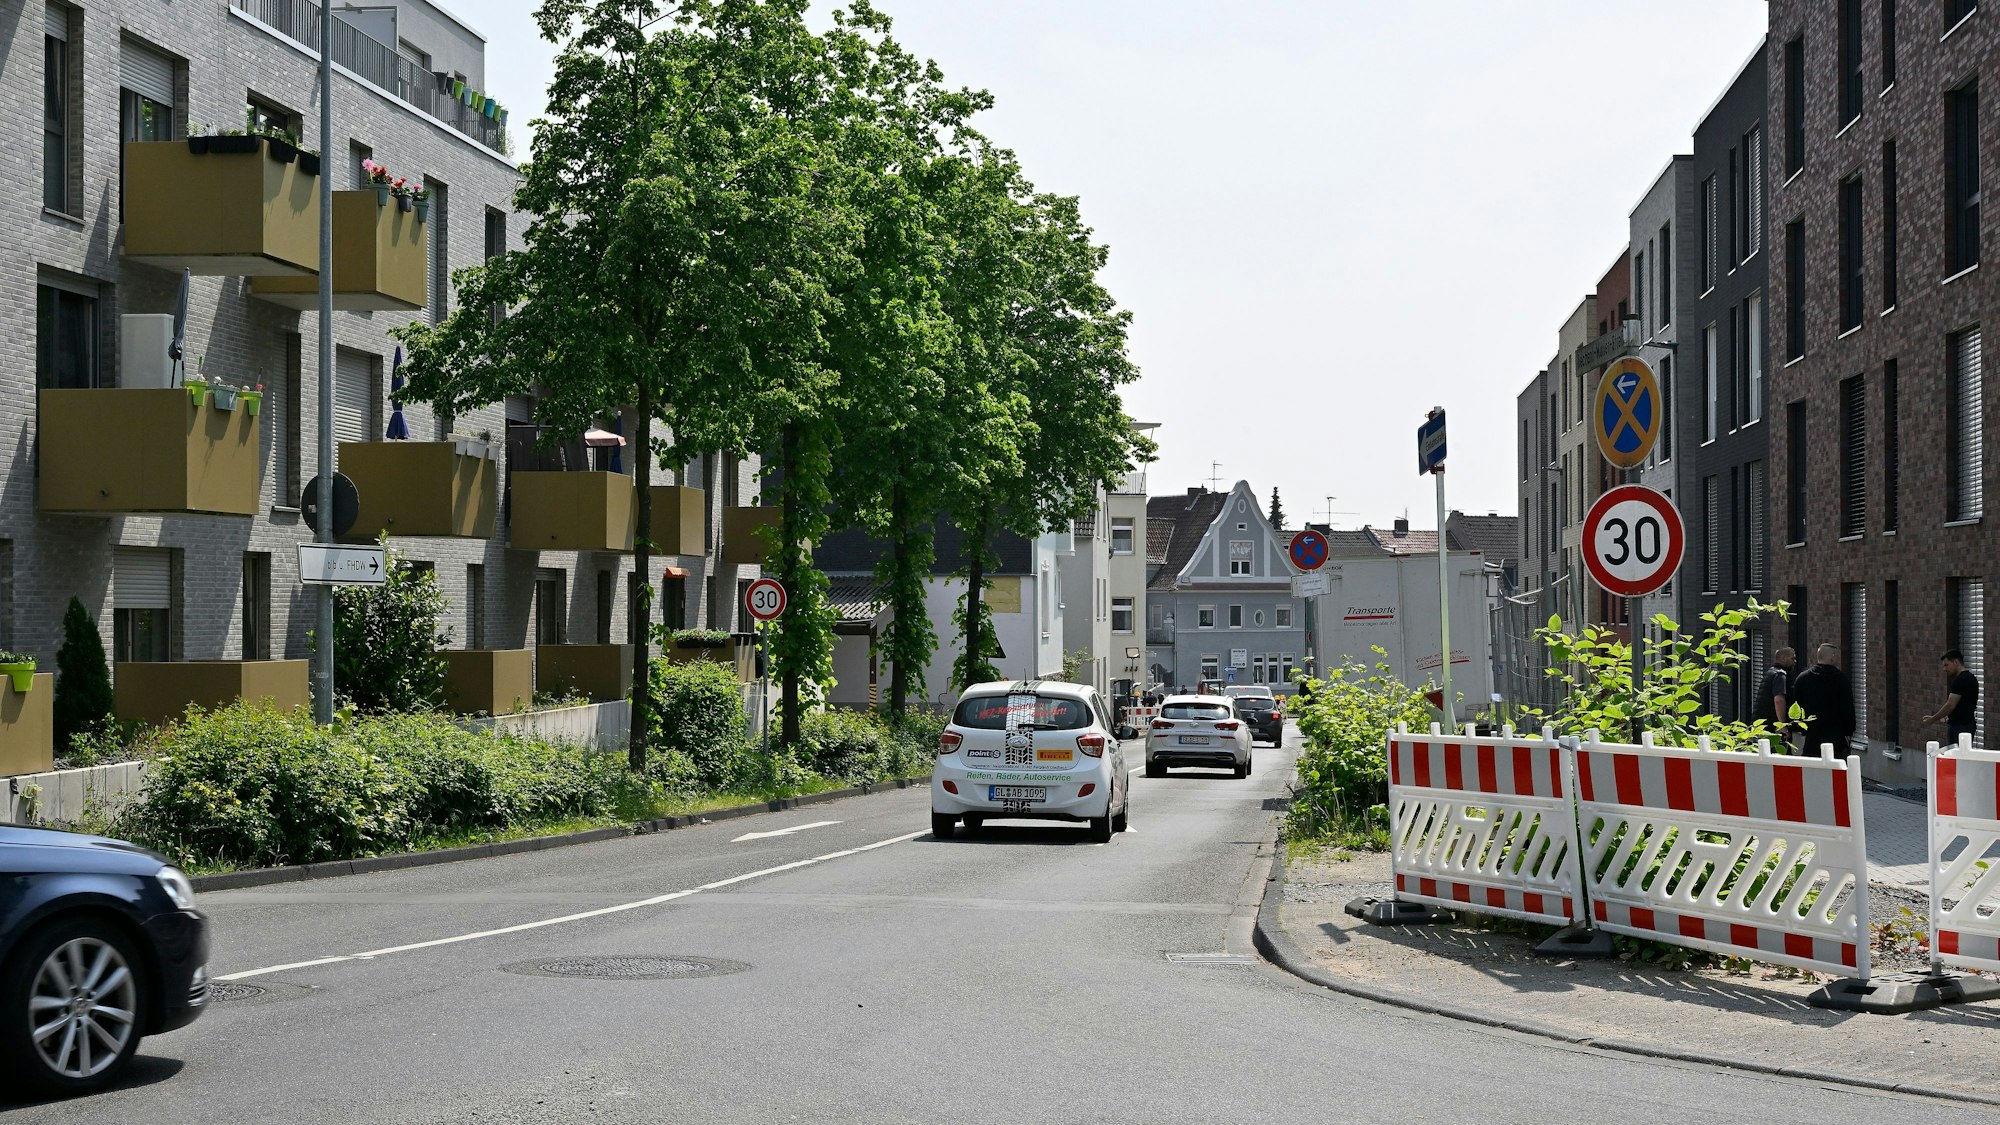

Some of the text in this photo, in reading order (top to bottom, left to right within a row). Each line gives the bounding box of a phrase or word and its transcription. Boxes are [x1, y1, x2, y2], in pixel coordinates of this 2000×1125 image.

[1603, 516, 1661, 566] 30
[346, 560, 366, 571] FHDW
[755, 591, 777, 609] 30
[1347, 606, 1396, 616] Transporte
[966, 772, 1072, 782] Reifen, Räder, Autoservice
[995, 788, 1045, 798] GL AB 1095
